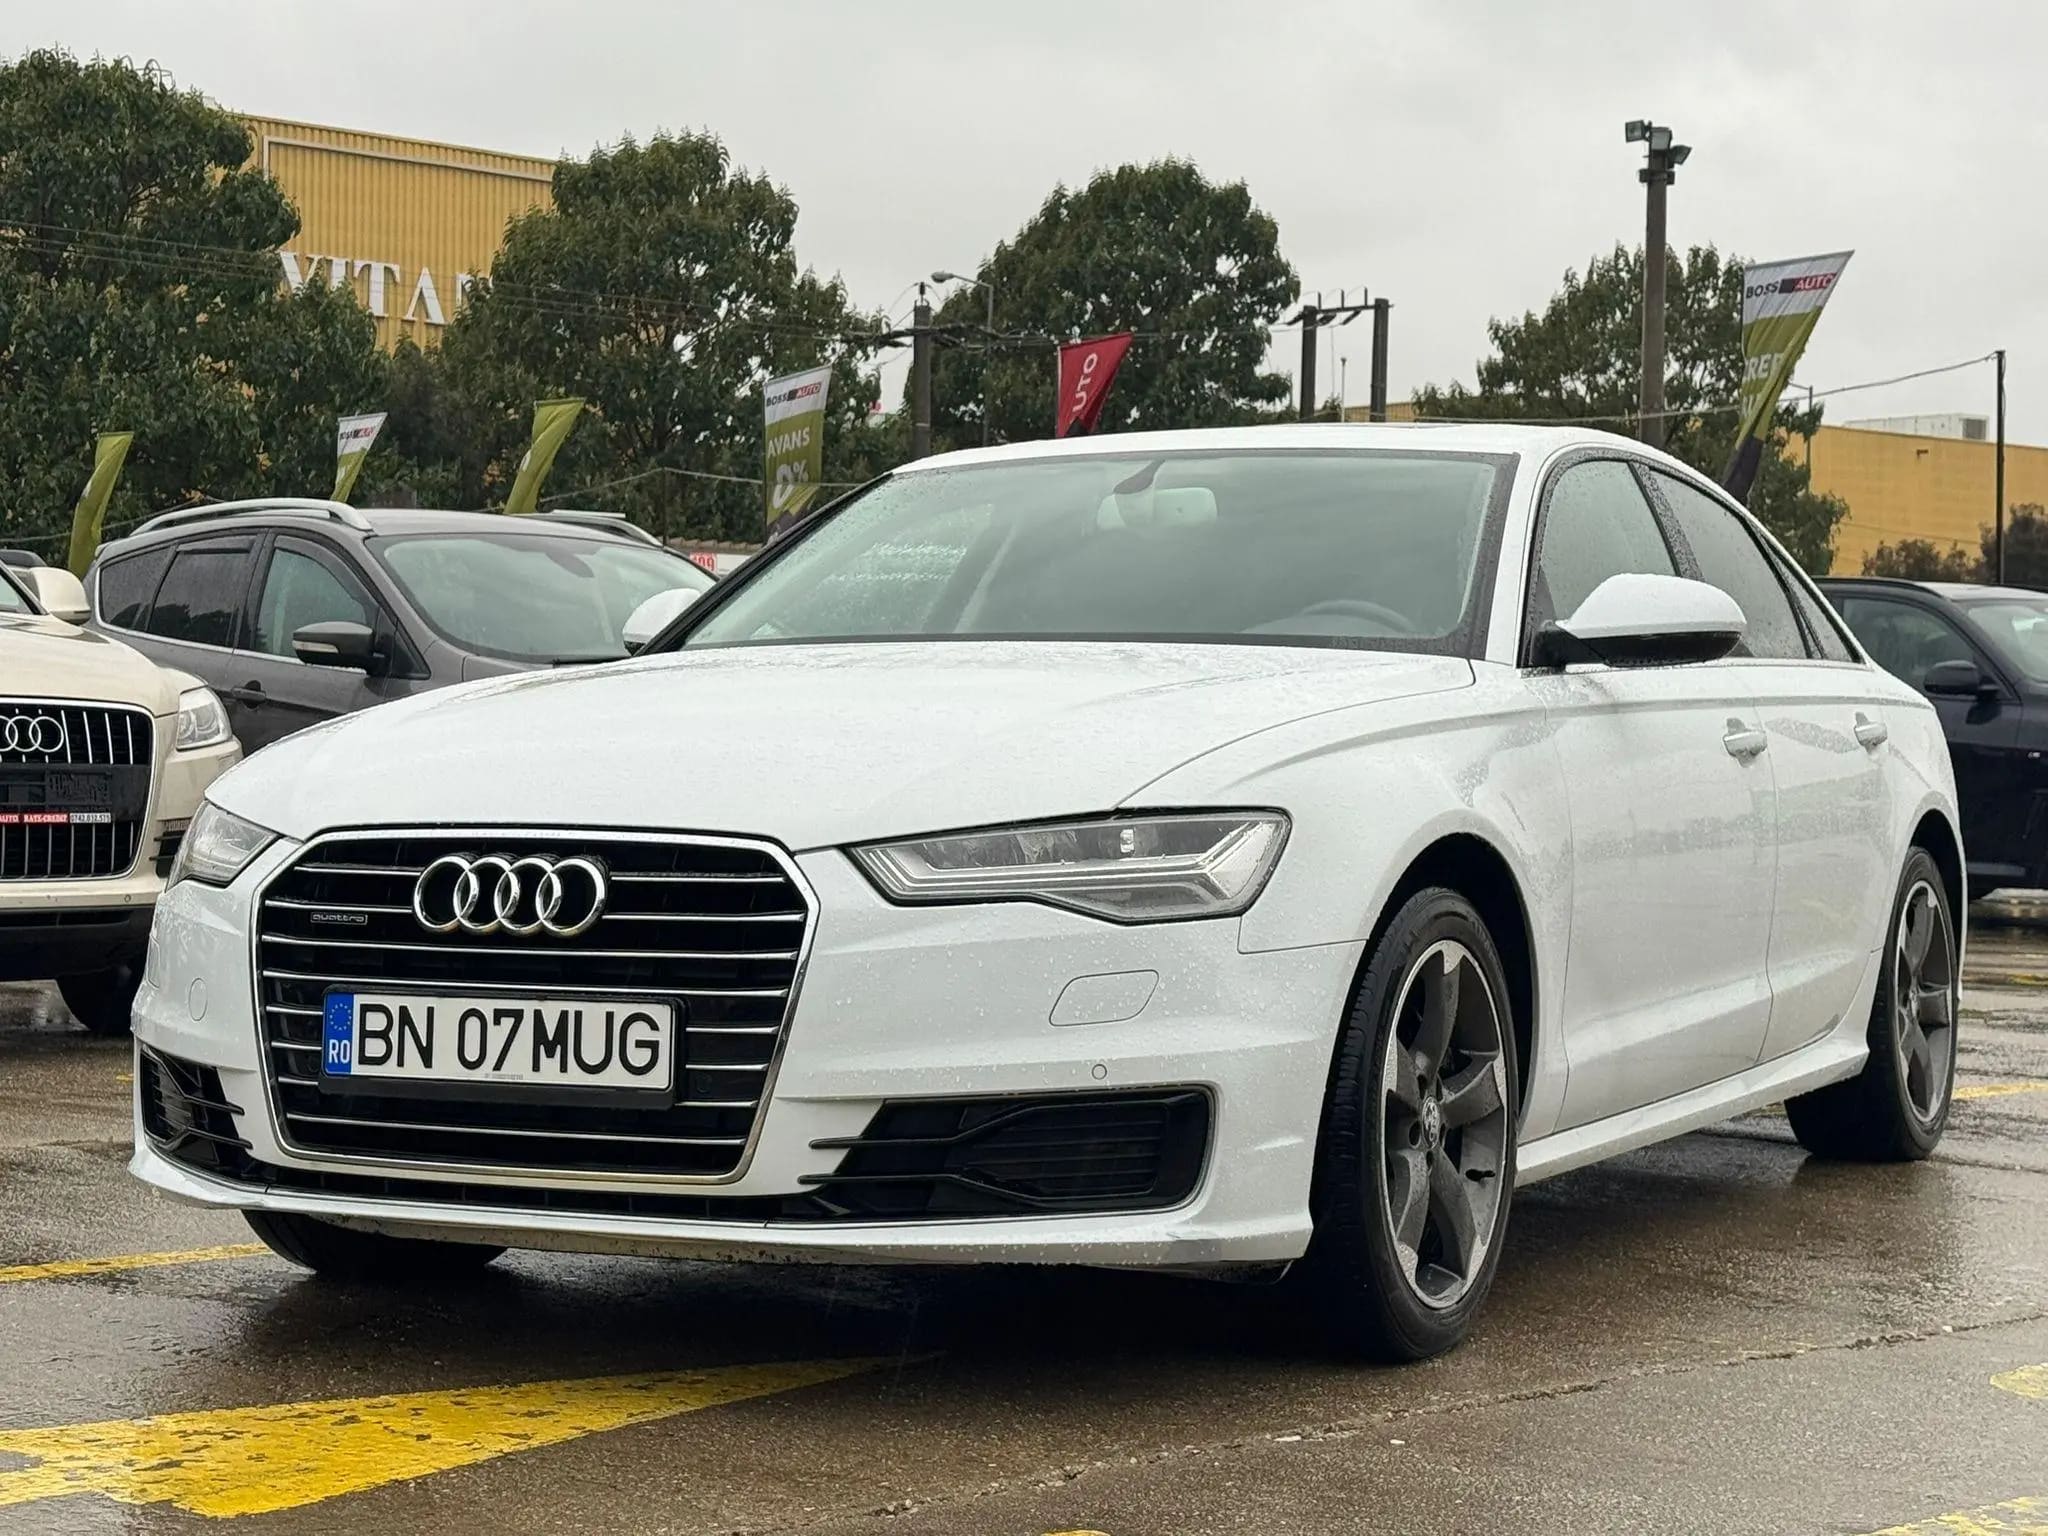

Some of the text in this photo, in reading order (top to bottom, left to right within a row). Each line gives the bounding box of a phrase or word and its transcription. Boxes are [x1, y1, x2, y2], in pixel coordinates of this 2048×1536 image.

[279, 251, 494, 326] VITA
[1746, 281, 1779, 298] BOSS
[767, 384, 820, 406] BOSS AUTO
[768, 427, 810, 458] AVANS
[312, 913, 365, 922] quattro
[328, 1039, 351, 1064] RO
[358, 1003, 660, 1076] BN 07 MUG
